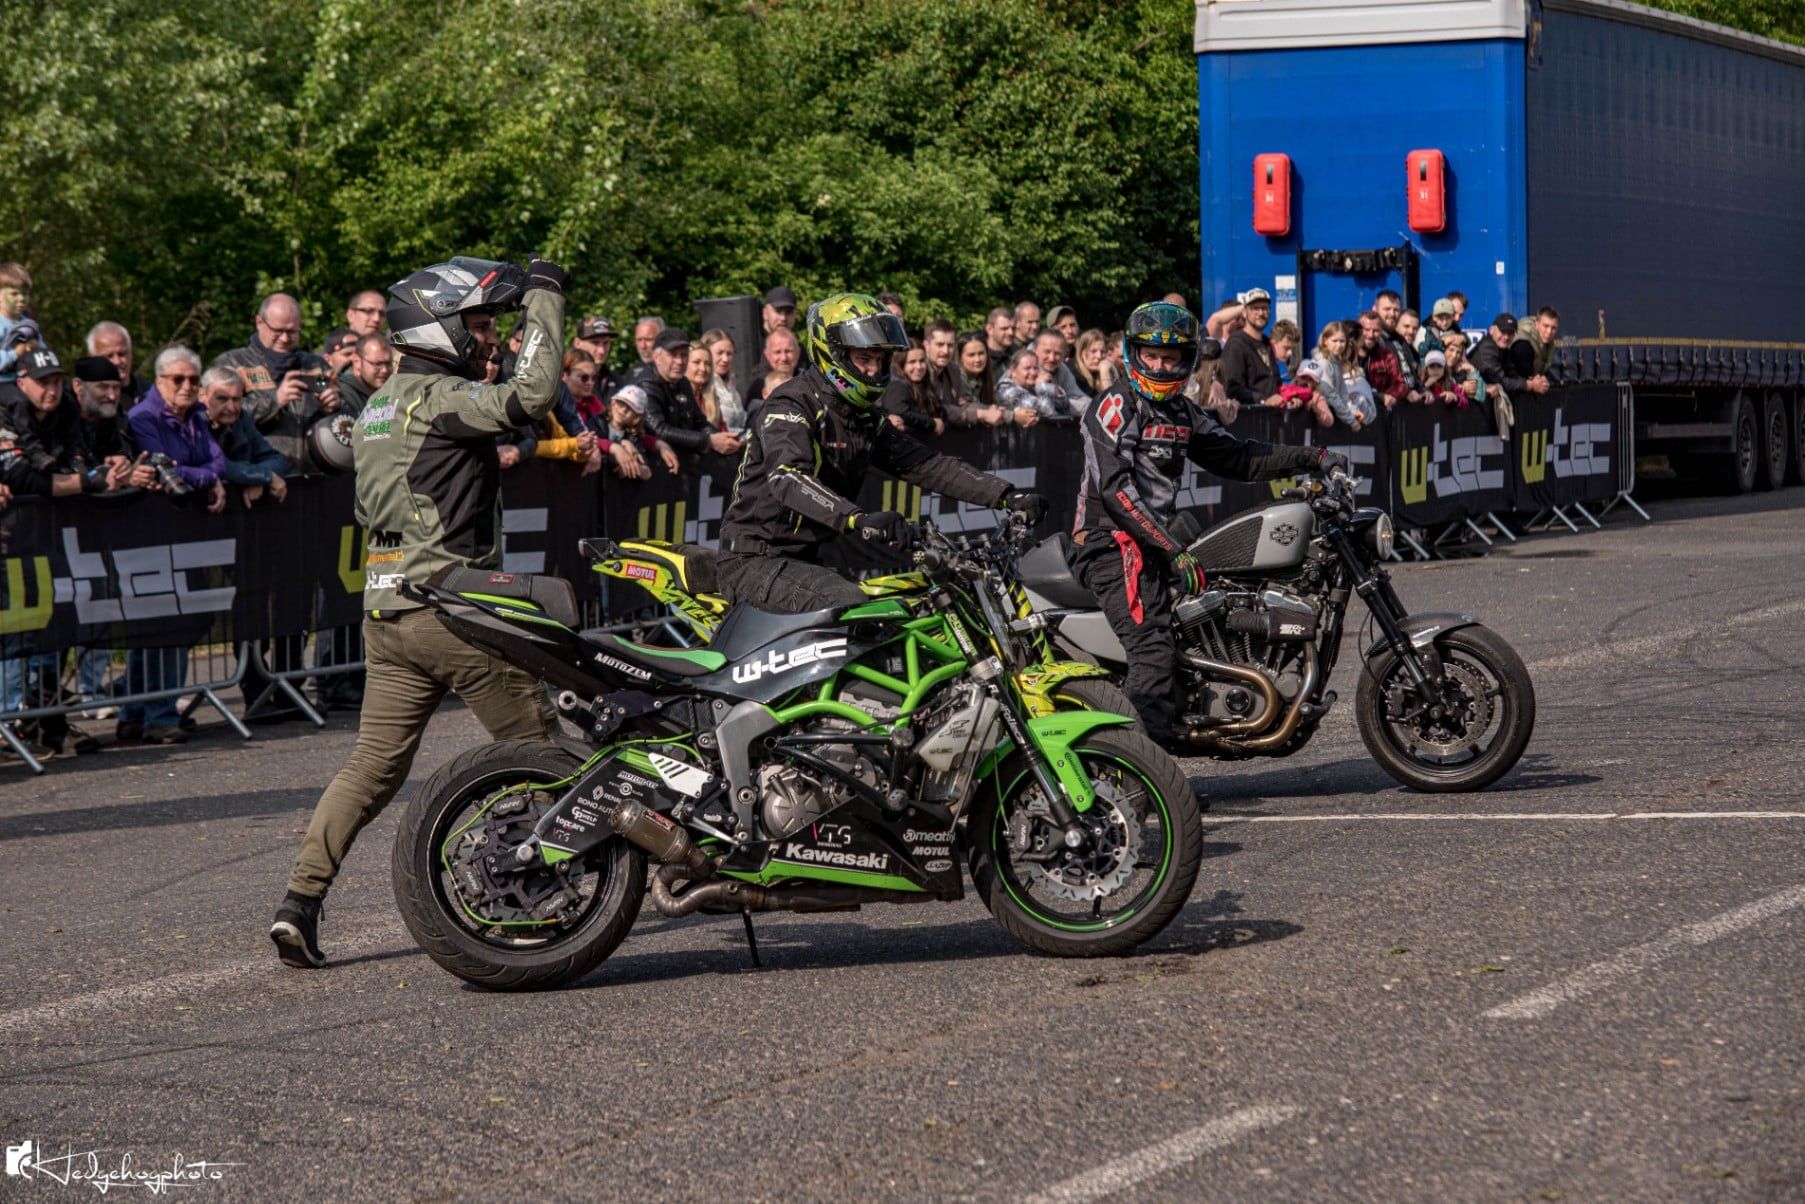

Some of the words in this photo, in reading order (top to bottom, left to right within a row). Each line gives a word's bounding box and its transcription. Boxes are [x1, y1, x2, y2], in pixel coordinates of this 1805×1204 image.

[1116, 490, 1134, 512] ICON
[628, 565, 655, 579] MOTUL
[577, 797, 599, 810] BONO
[786, 843, 888, 869] Kawasaki
[912, 846, 950, 856] MOTUL
